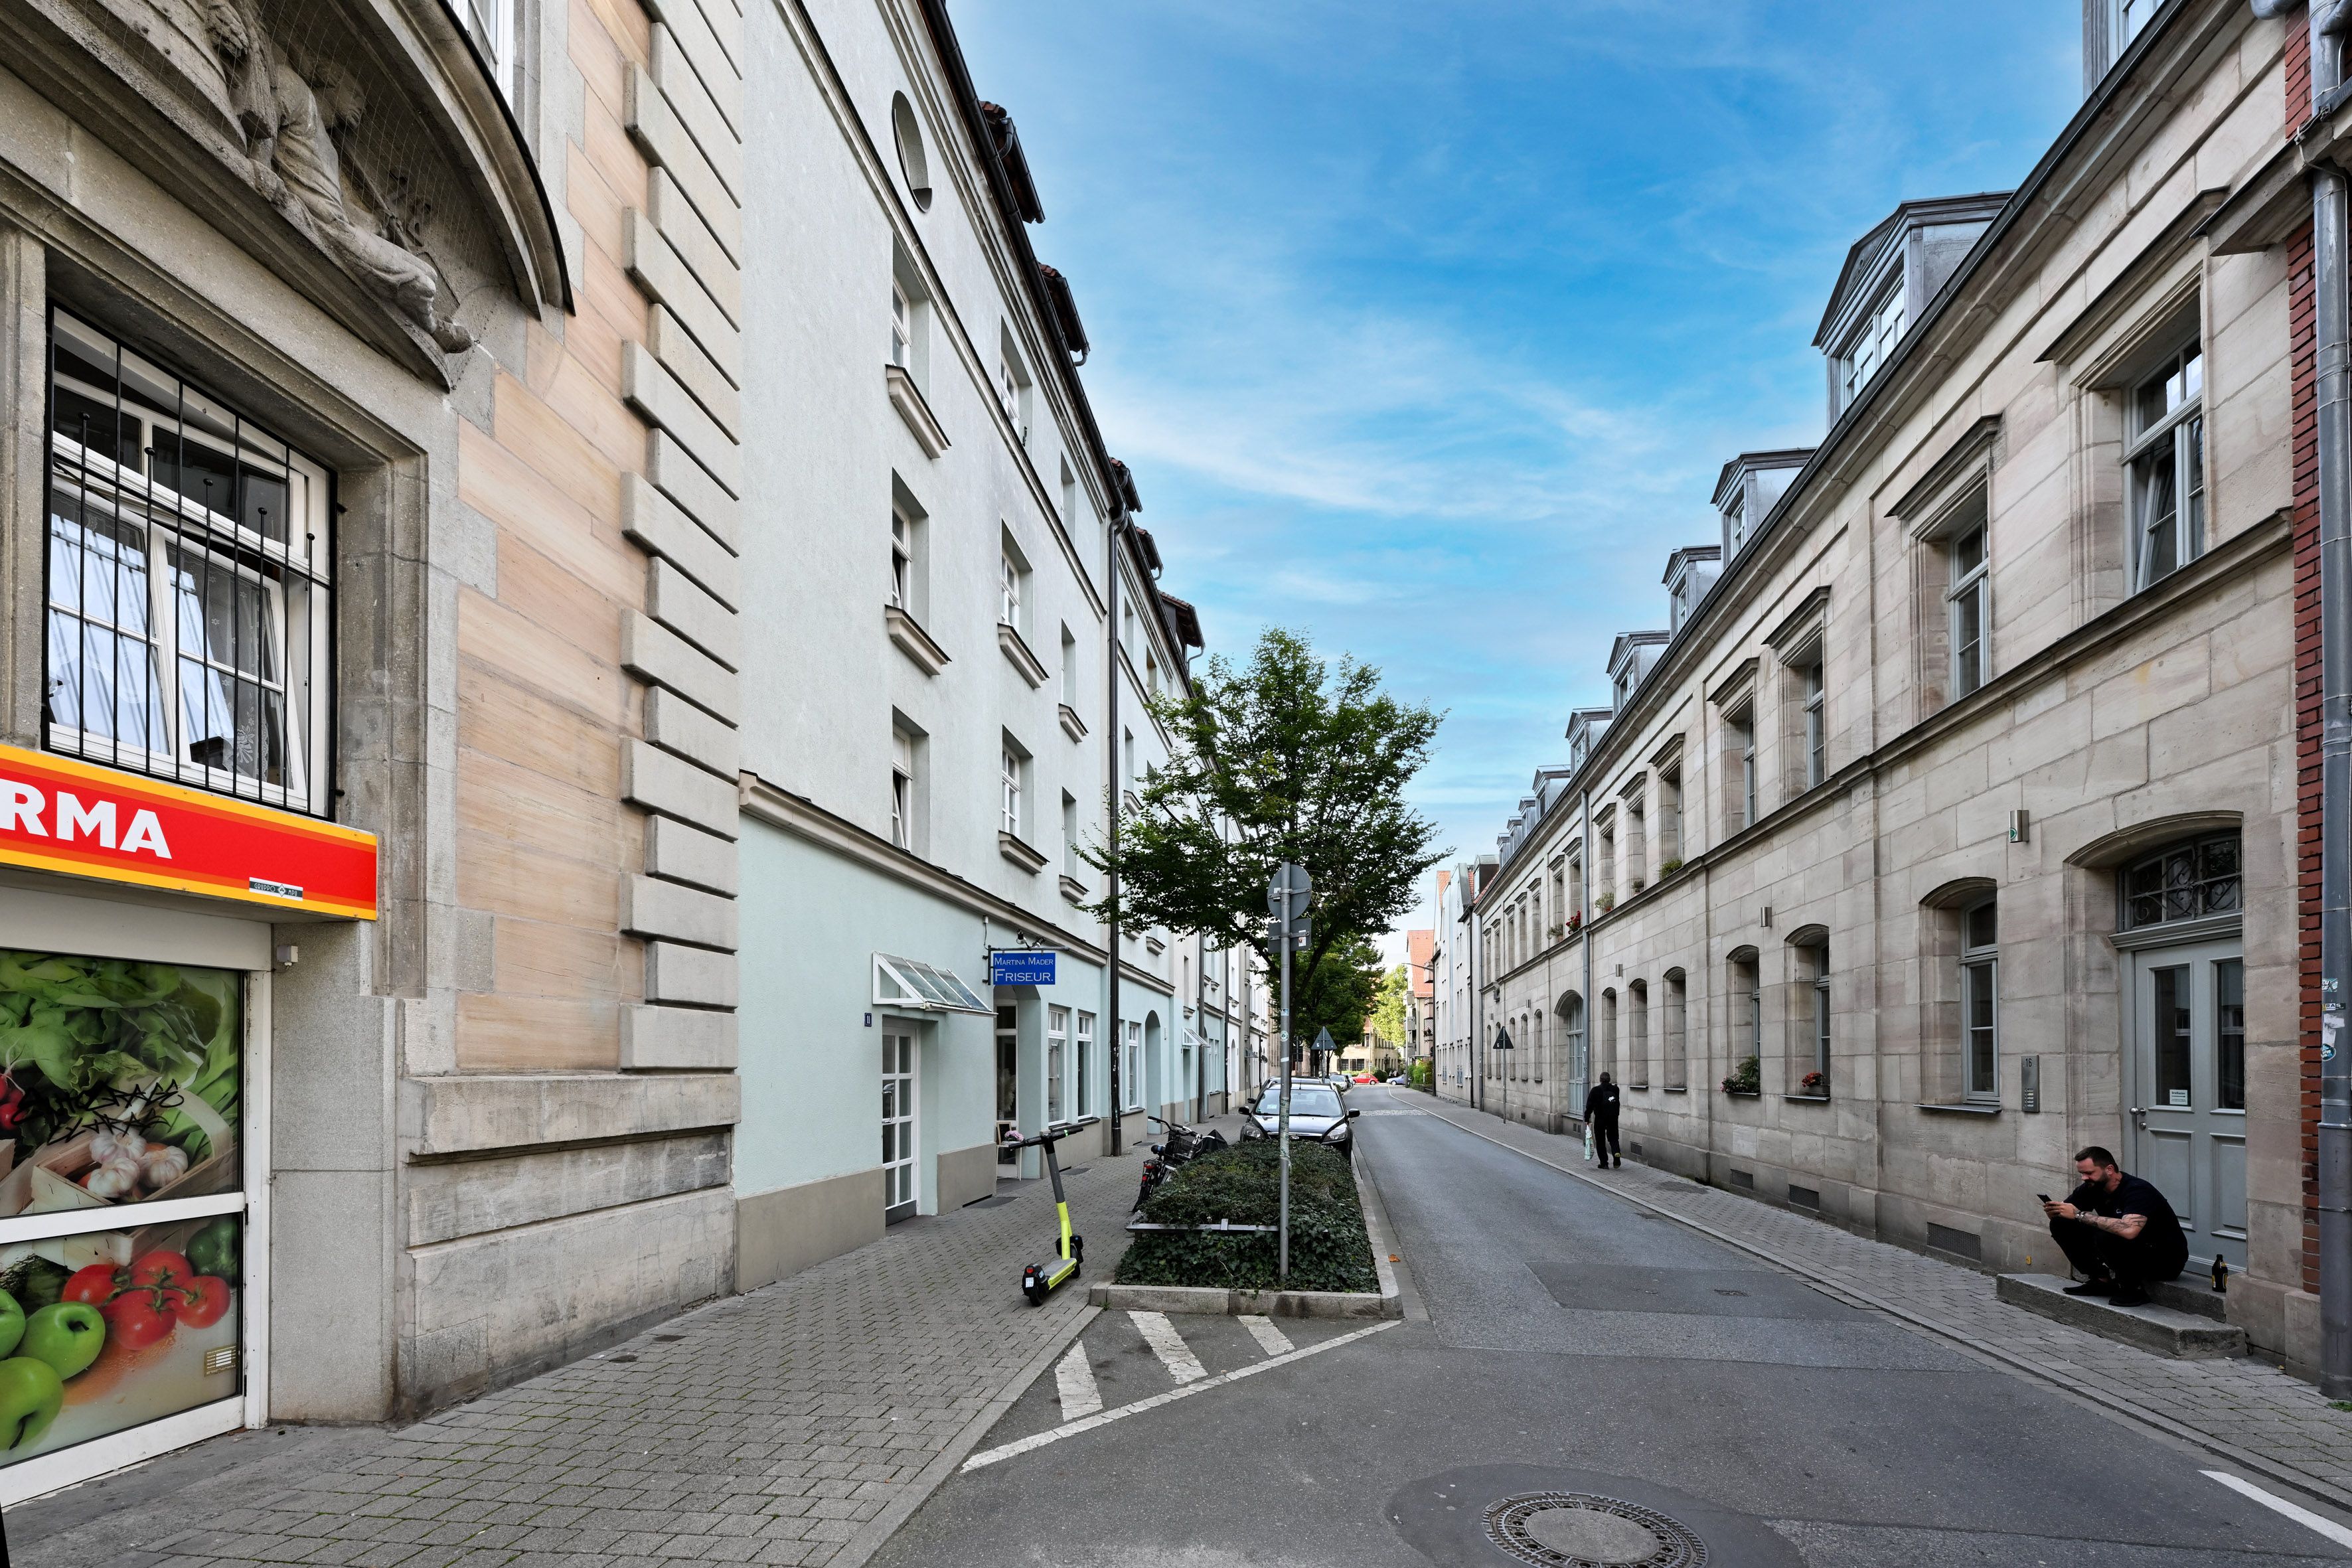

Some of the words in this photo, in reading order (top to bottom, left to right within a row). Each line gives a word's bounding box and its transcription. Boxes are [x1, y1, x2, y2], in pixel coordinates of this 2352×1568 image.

[0, 778, 172, 859] RMA
[254, 883, 275, 892] GRUPPO
[994, 969, 1054, 982] FRISEUR.
[2025, 1058, 2032, 1067] 16
